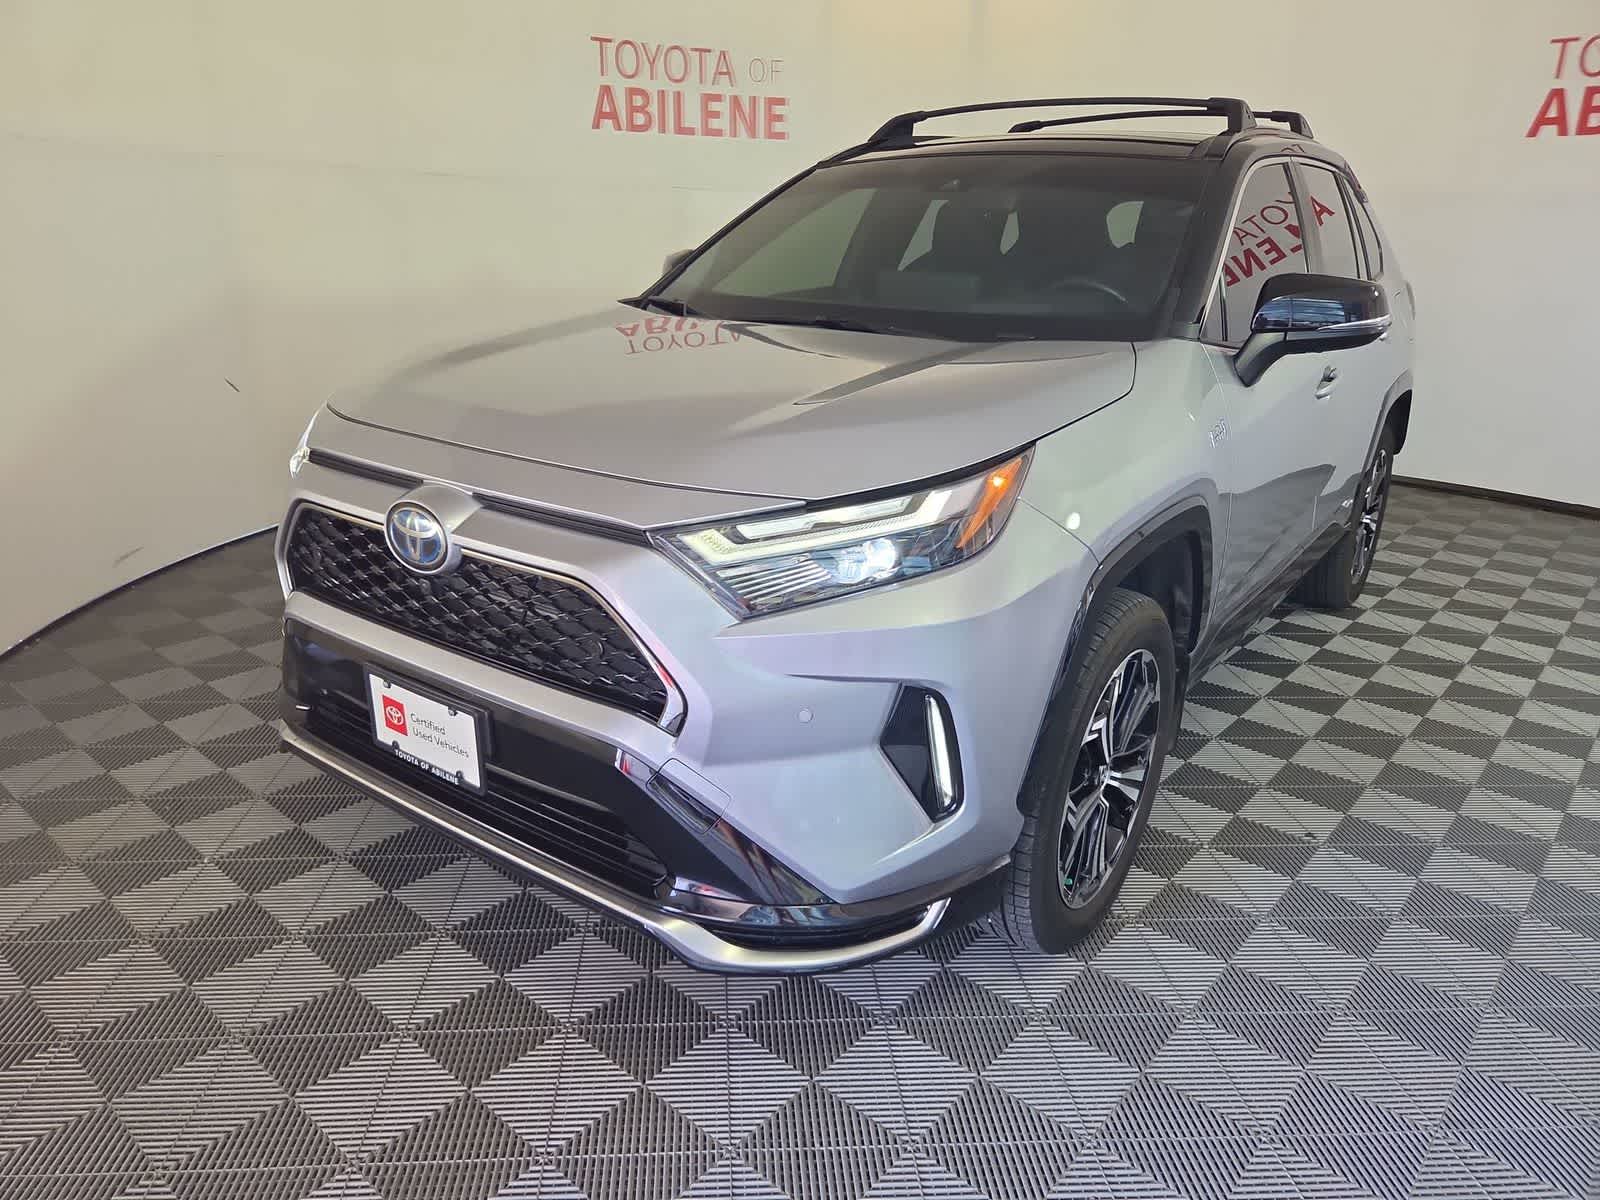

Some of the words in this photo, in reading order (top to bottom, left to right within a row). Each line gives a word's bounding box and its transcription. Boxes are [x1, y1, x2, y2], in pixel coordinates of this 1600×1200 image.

[590, 36, 734, 87] TOYOTA
[748, 57, 784, 84] OF
[591, 84, 789, 140] ABILENE
[410, 713, 446, 735] Certified
[412, 726, 433, 742] Used
[434, 736, 469, 758] Vehicles
[394, 749, 419, 766] TOYOTA
[421, 761, 430, 770] OF
[431, 766, 459, 785] ABILENE
